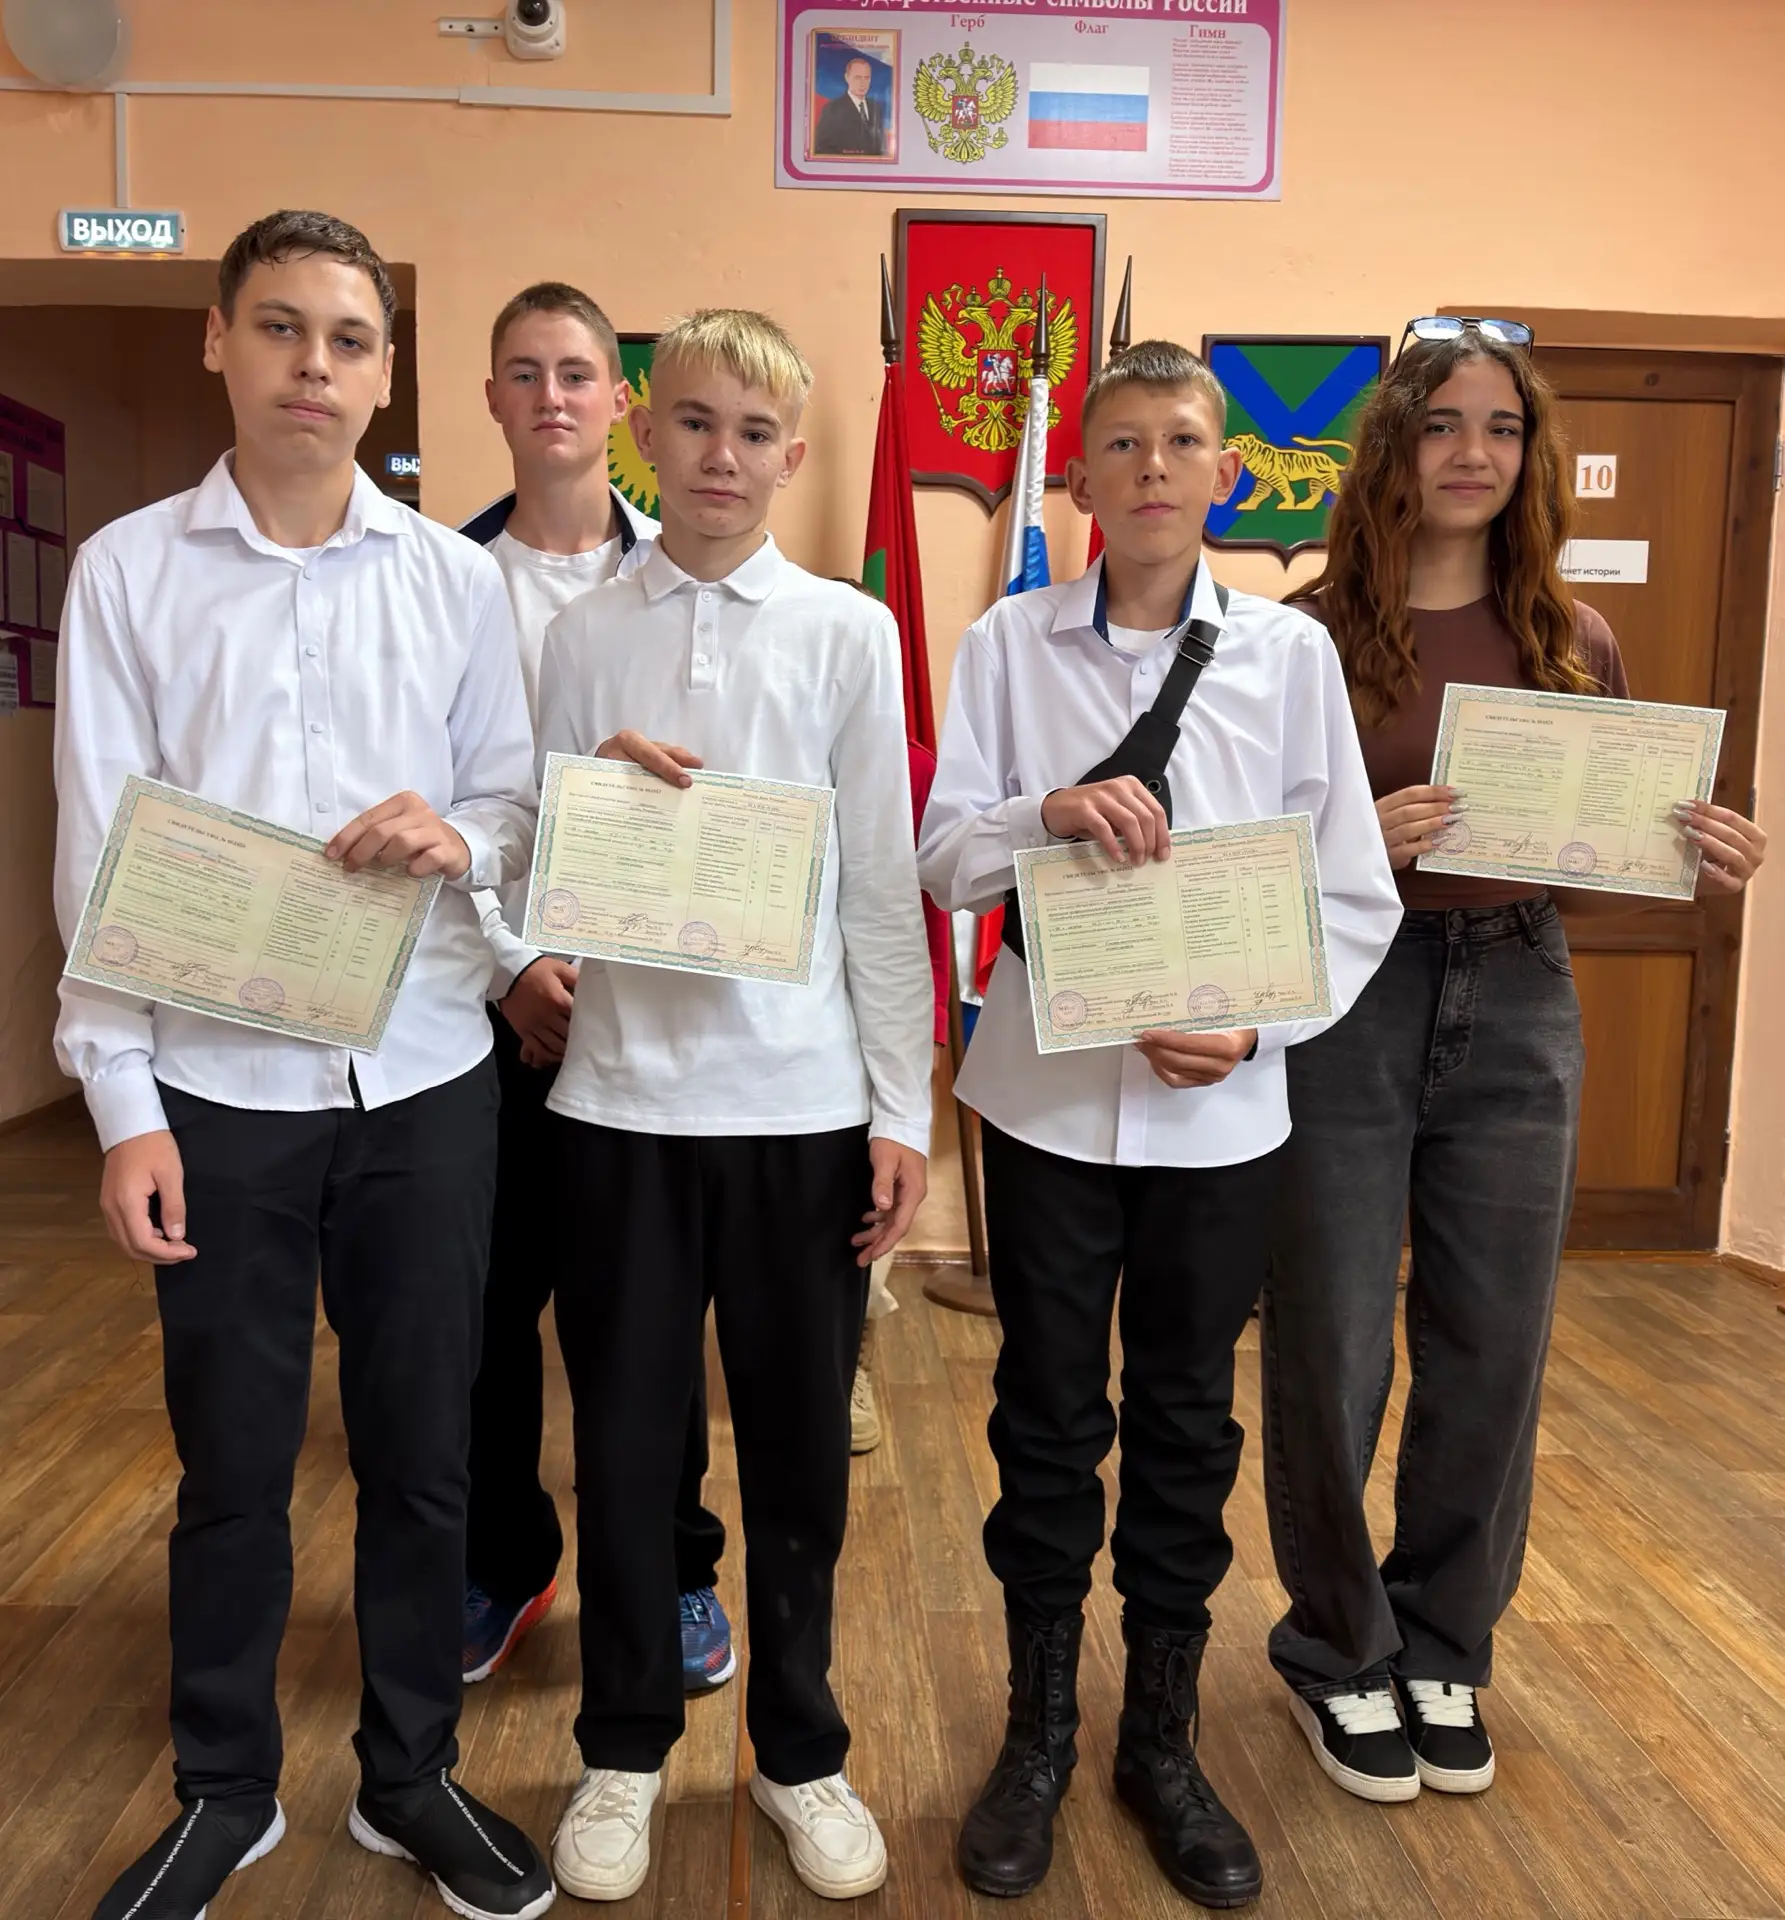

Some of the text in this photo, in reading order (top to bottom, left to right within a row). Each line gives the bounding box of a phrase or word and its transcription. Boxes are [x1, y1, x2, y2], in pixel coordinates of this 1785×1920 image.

[950, 13, 985, 32] Герб
[1074, 19, 1109, 34] Флаг
[1190, 24, 1226, 39] Гимн
[73, 218, 174, 245] ВЫХОД
[1581, 464, 1613, 490] 10
[1583, 568, 1621, 578] истории
[133, 1886, 154, 1908] SPORTS
[150, 1863, 170, 1887] SPORTS
[166, 1839, 185, 1864] SPORTS
[180, 1814, 197, 1839] SPORTS
